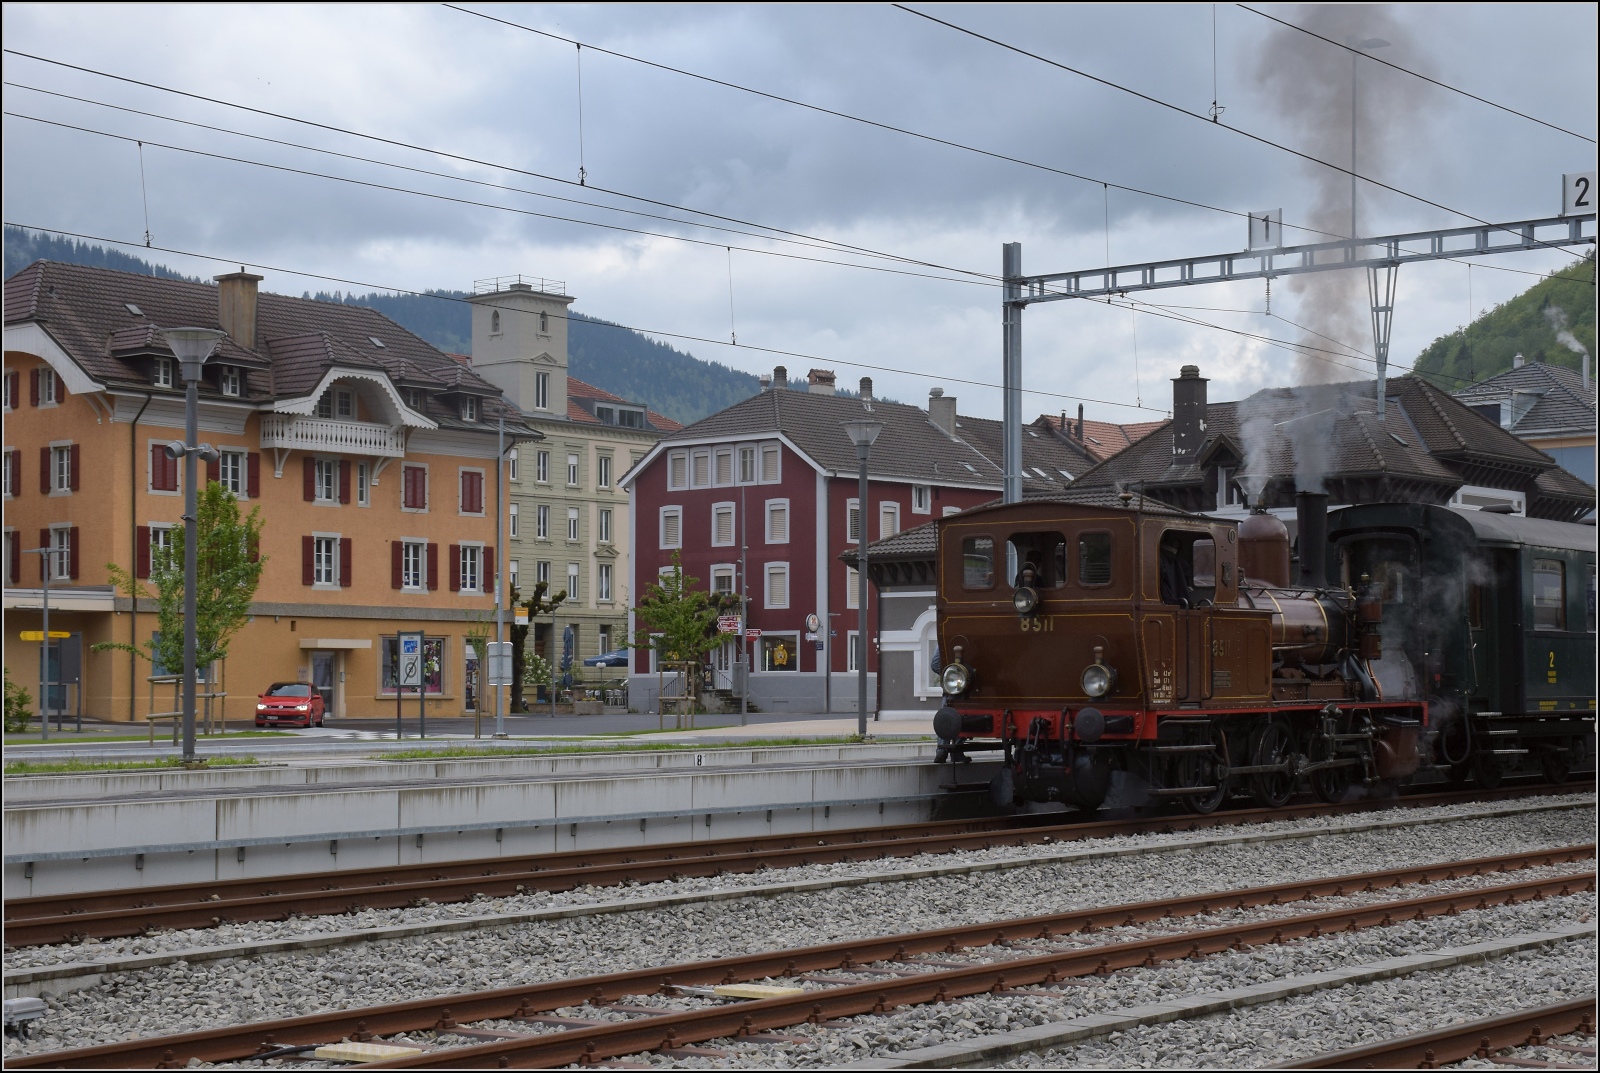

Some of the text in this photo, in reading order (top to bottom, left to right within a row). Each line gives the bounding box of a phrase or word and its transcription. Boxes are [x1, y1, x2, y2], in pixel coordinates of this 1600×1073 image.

[1575, 177, 1590, 207] 2
[1261, 215, 1270, 242] 1
[1020, 615, 1054, 632] 8511
[1212, 639, 1230, 657] 8511
[1549, 651, 1555, 668] 2
[697, 754, 703, 766] 8
